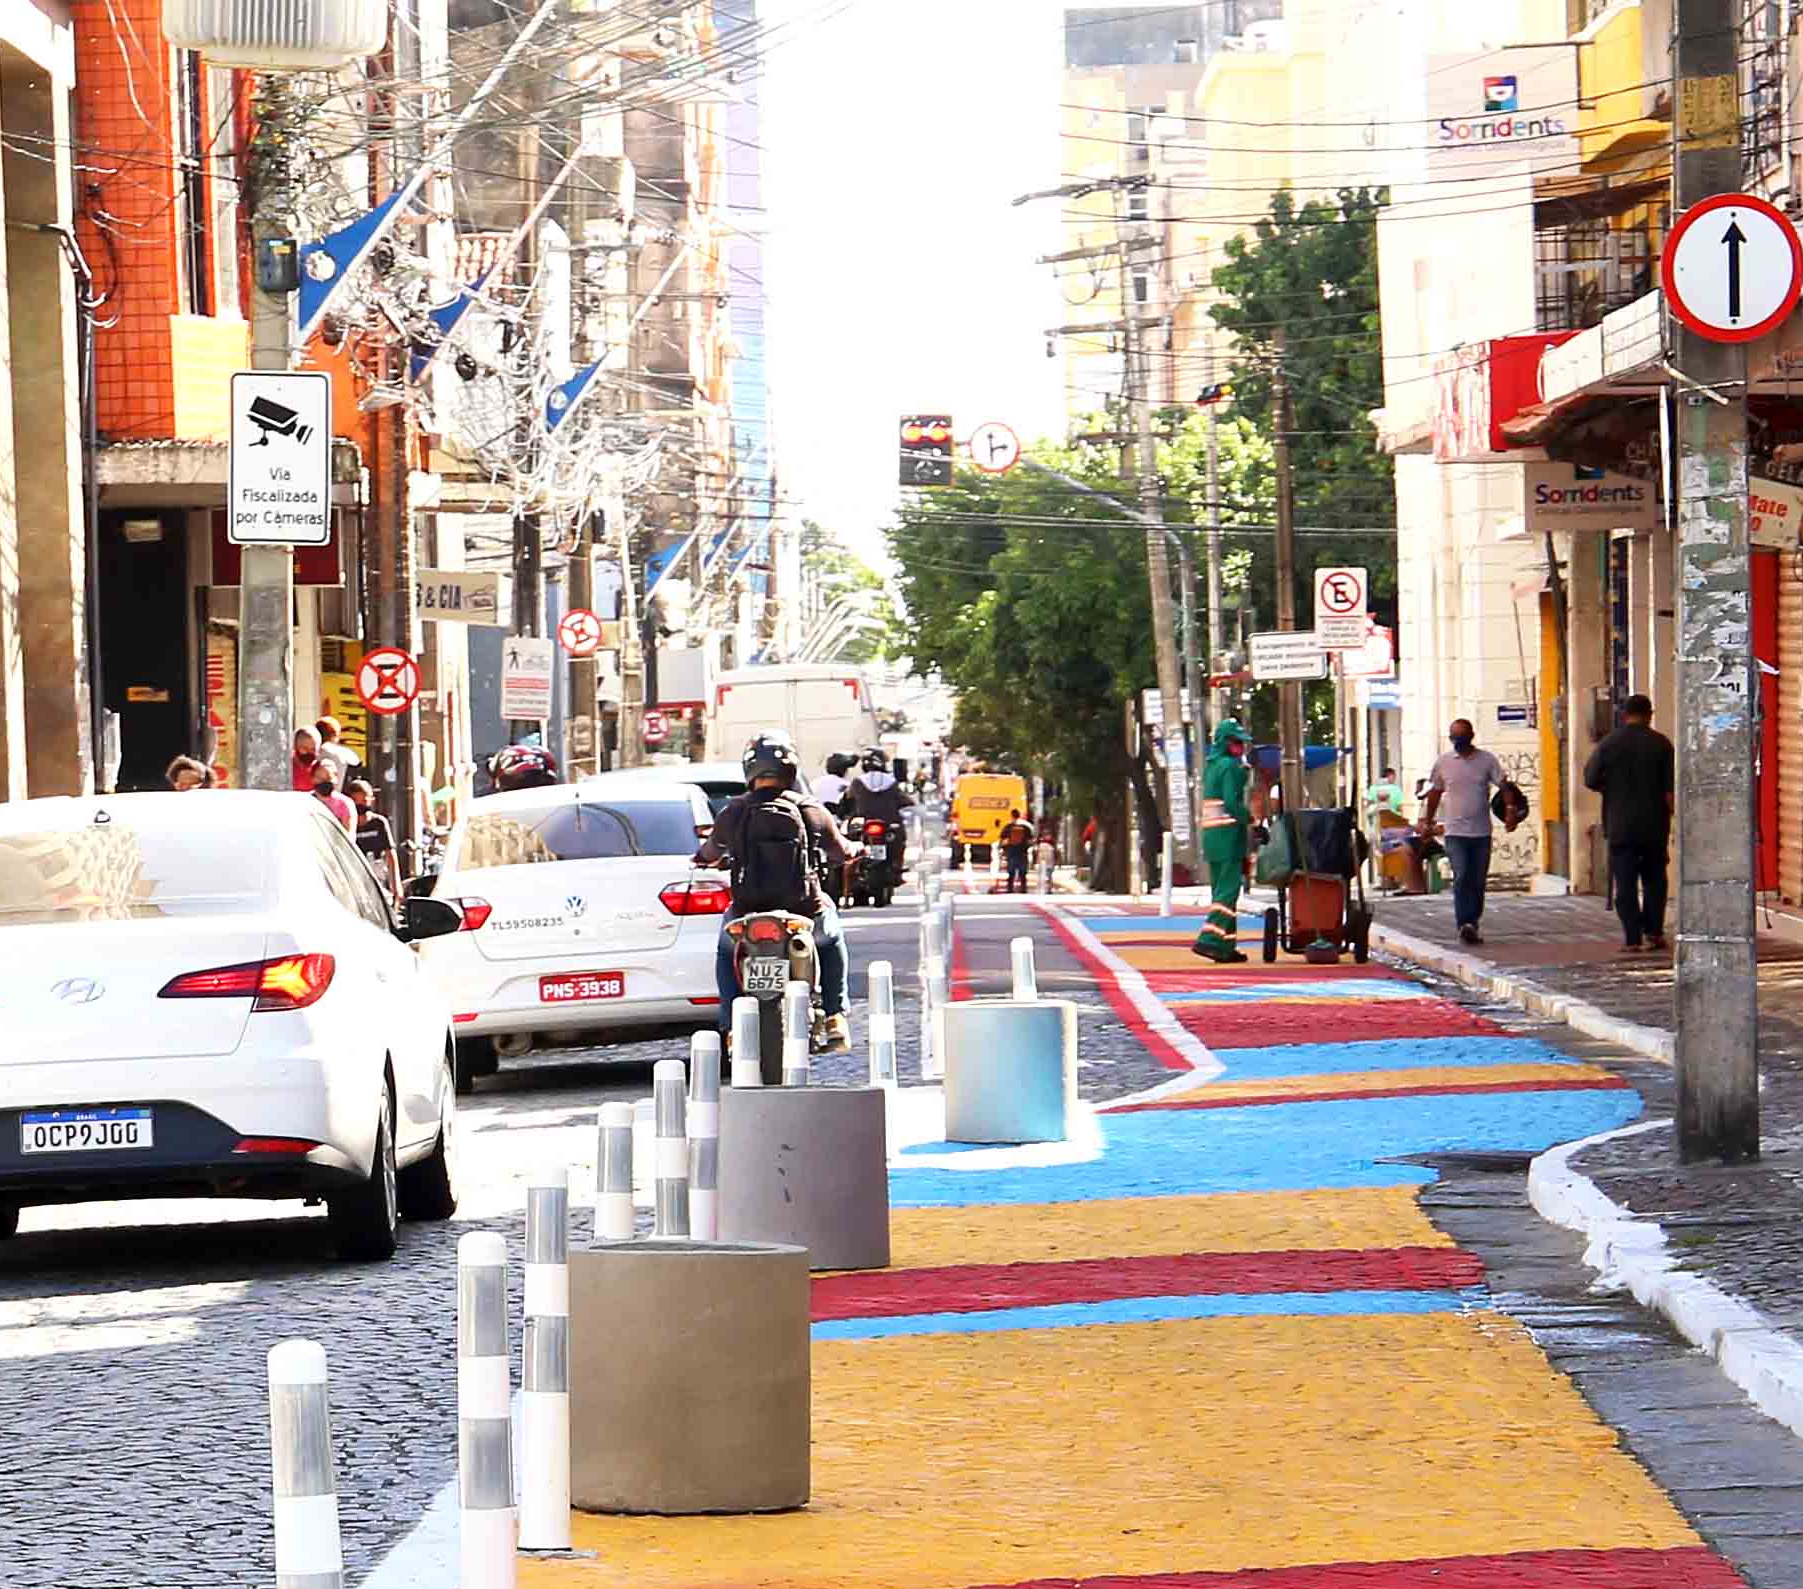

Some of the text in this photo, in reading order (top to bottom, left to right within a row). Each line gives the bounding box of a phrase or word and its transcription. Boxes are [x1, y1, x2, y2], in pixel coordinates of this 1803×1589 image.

[1439, 117, 1565, 140] Sorridents
[269, 466, 291, 481] Via
[242, 488, 318, 503] Fiscalizada
[1535, 483, 1645, 504] Sorridents
[236, 512, 257, 526] por
